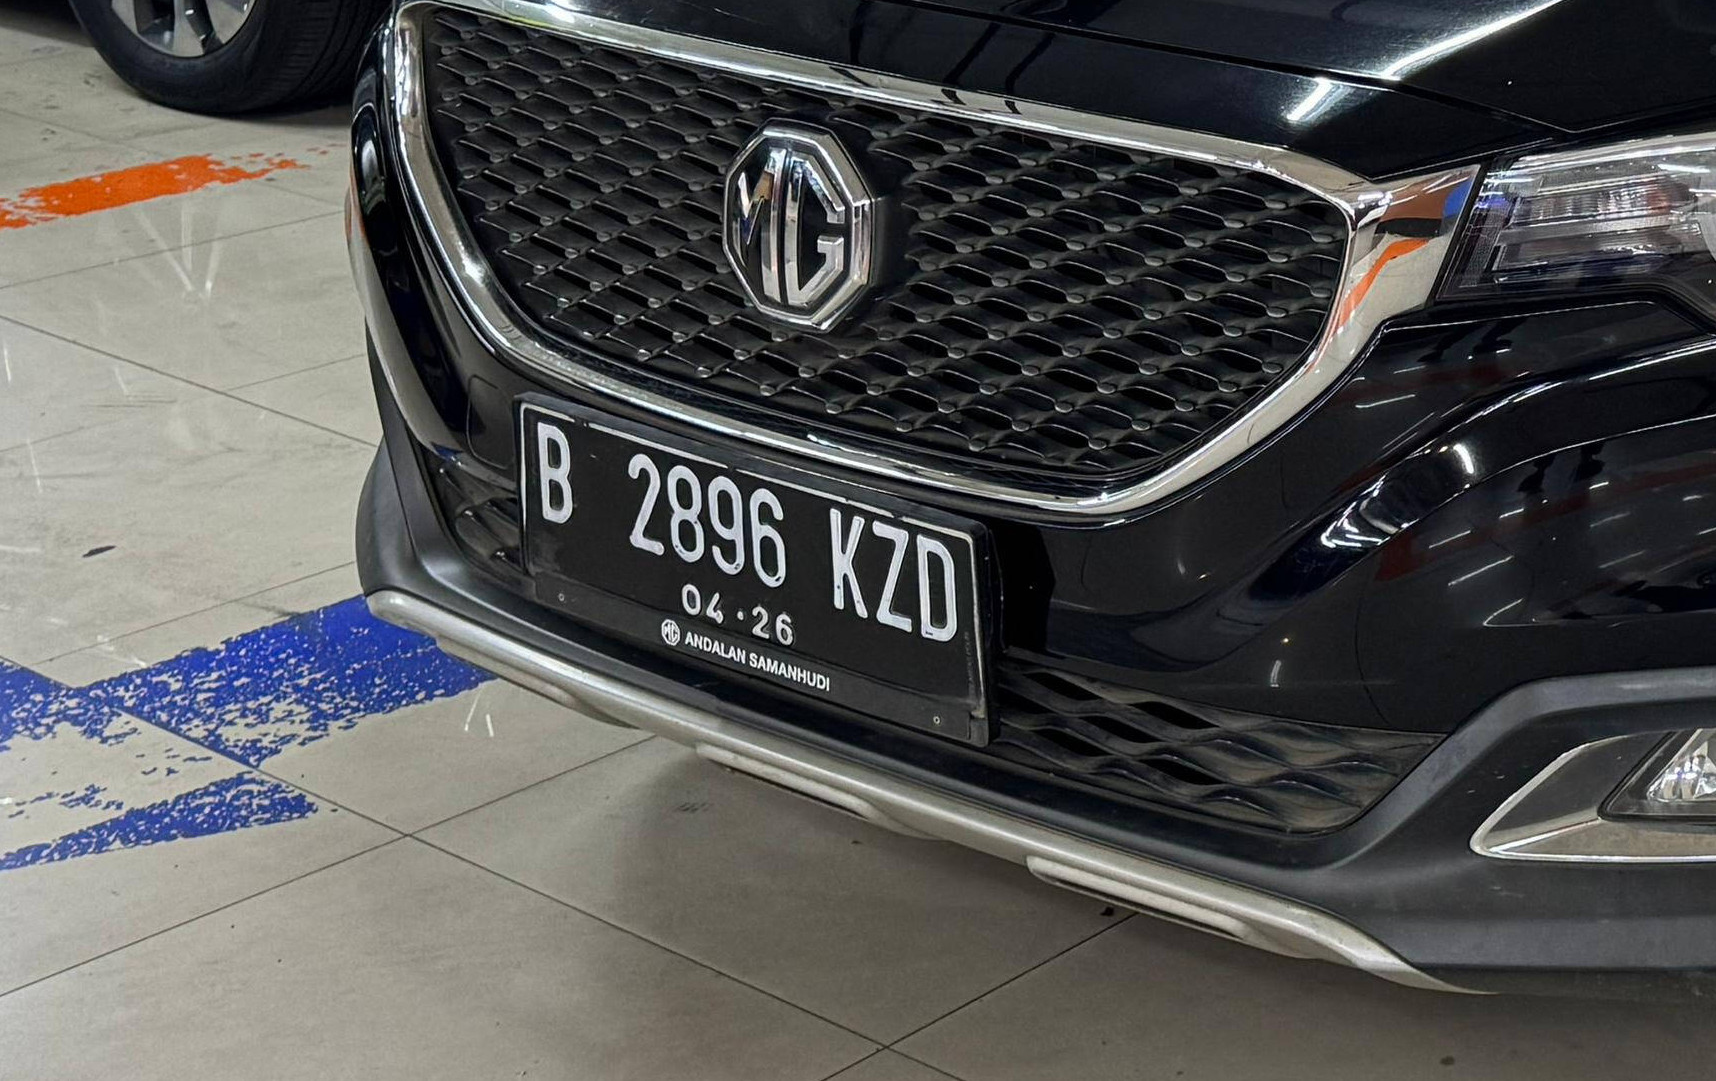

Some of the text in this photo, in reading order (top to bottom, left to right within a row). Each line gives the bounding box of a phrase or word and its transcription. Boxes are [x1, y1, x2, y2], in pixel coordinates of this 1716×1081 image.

[730, 137, 852, 317] MG
[537, 421, 959, 642] B 2896 KZD
[685, 631, 746, 665] ANDALAN
[749, 652, 831, 692] SAMANHUDI
